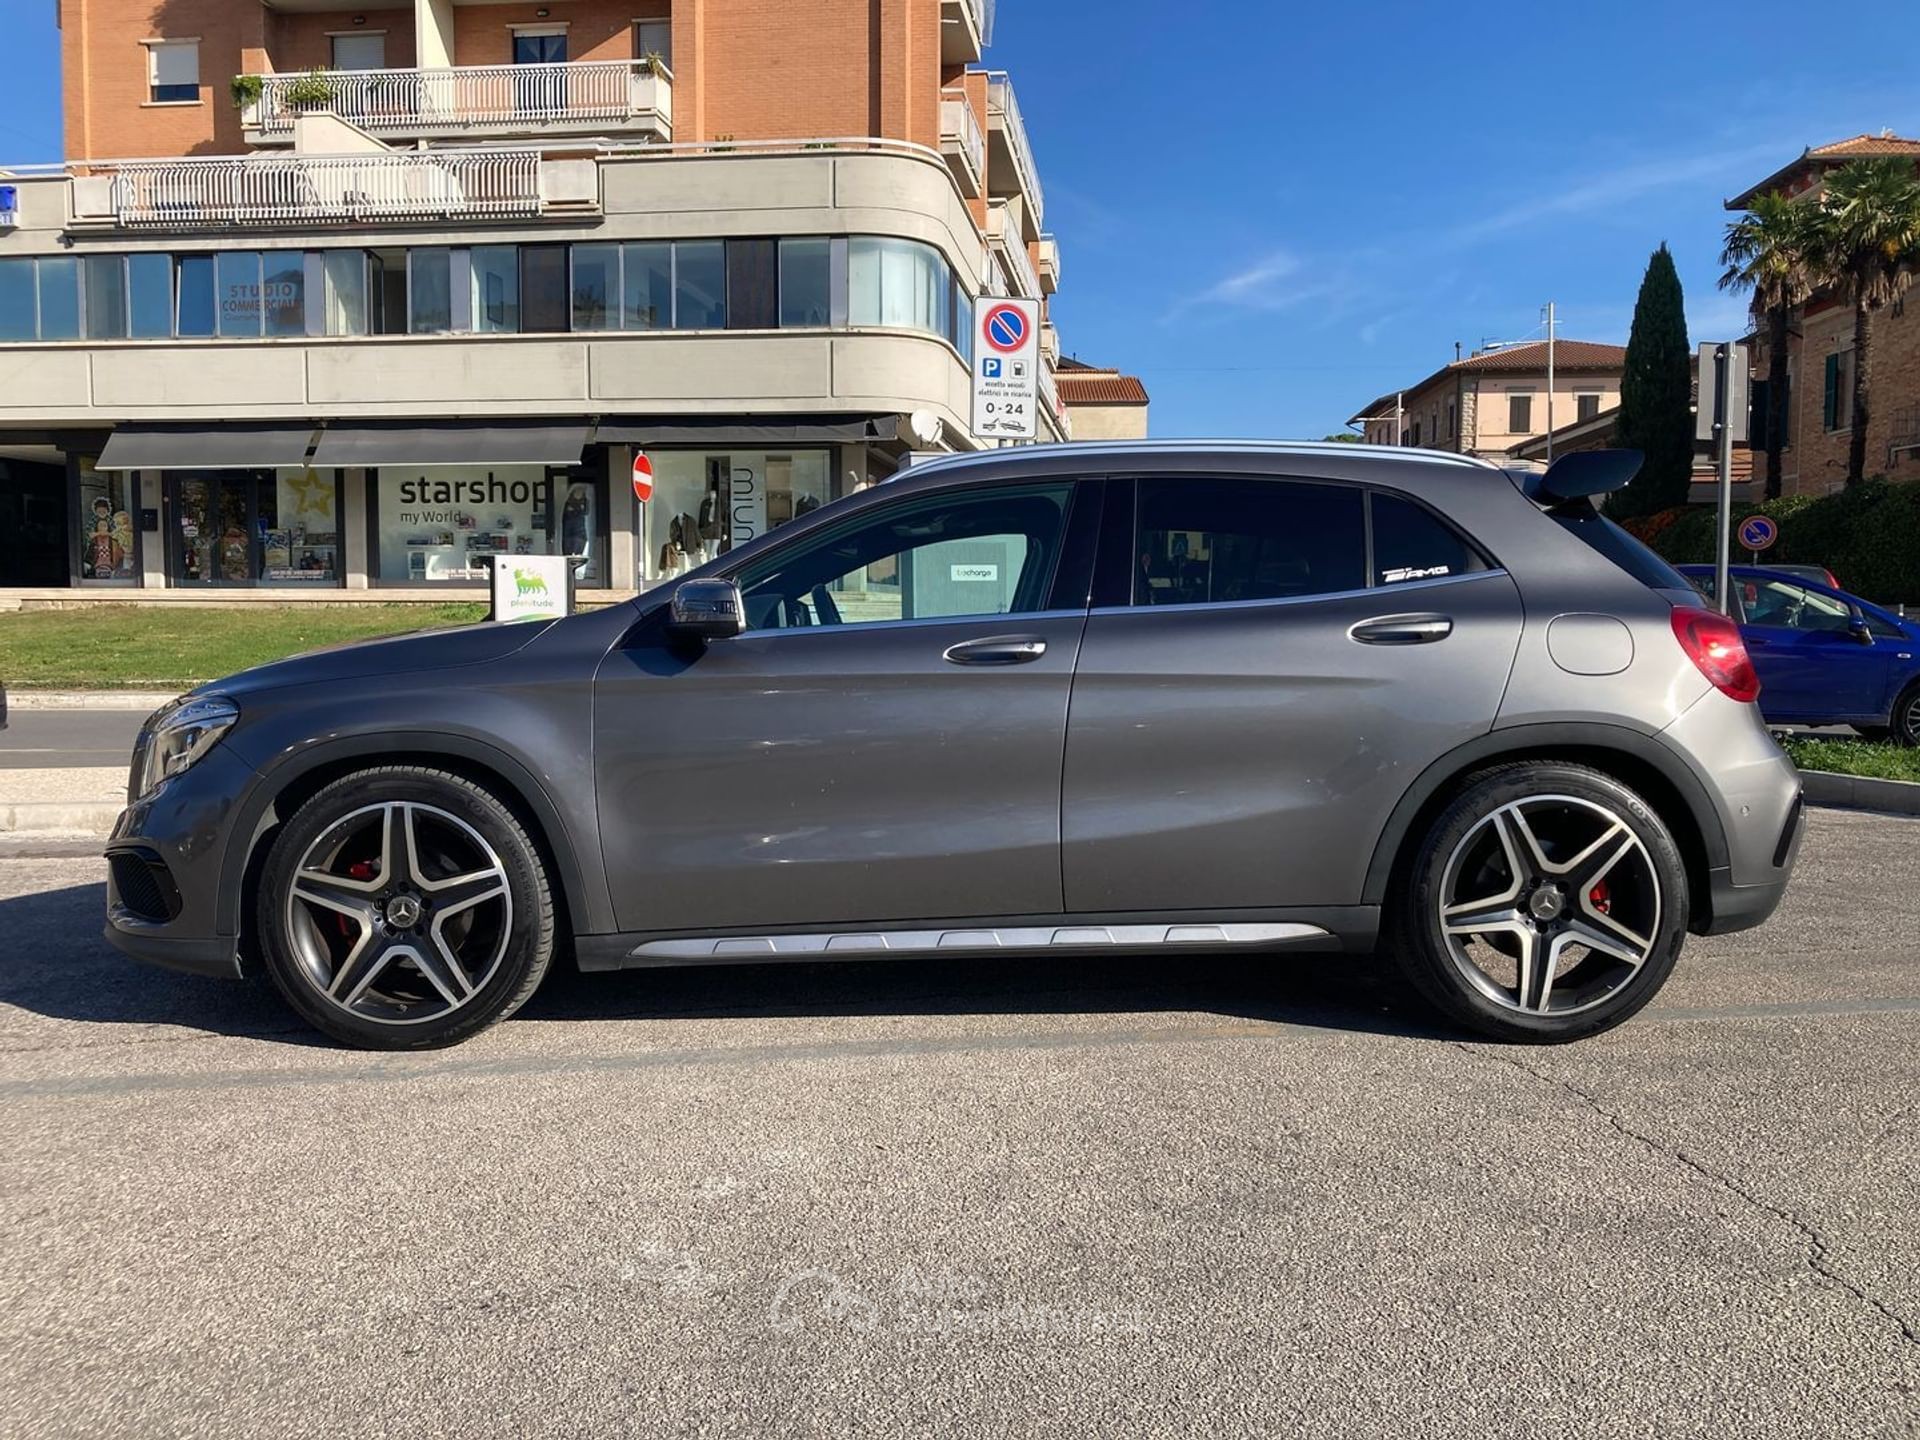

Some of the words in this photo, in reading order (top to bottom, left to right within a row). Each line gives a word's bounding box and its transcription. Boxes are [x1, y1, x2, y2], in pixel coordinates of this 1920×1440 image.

[230, 284, 292, 298] STUDIO
[985, 360, 998, 376] P
[400, 472, 546, 512] starshop
[401, 514, 419, 525] my
[422, 510, 462, 523] World
